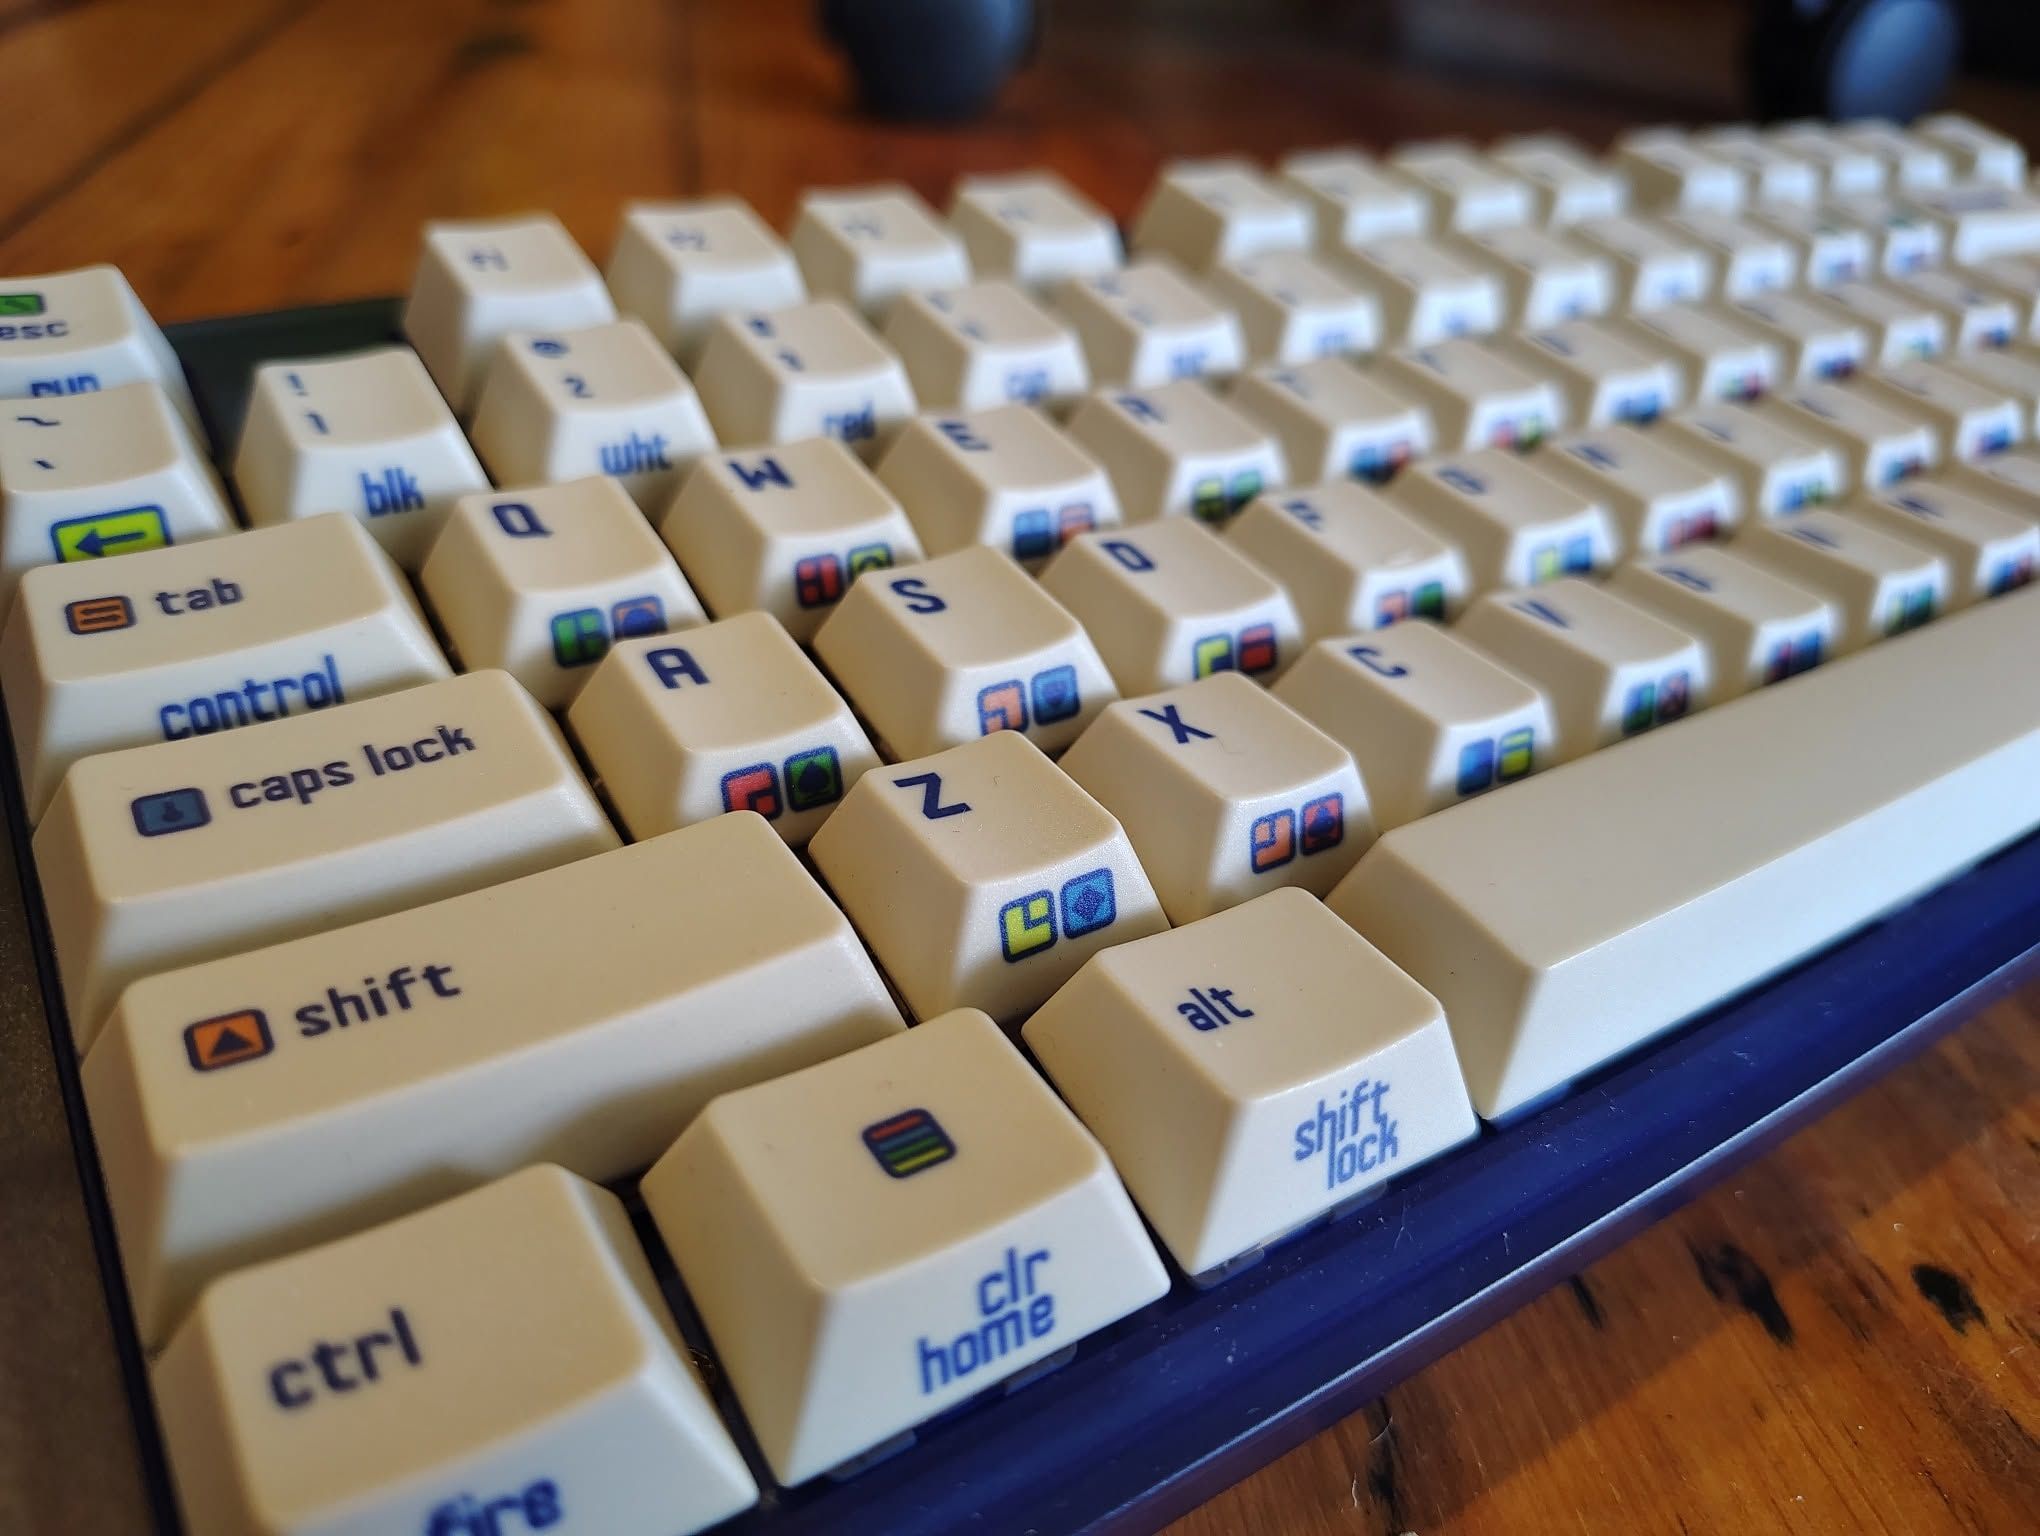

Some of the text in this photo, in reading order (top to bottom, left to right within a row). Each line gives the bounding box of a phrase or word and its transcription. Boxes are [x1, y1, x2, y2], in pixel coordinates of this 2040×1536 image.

[0, 320, 68, 341] esc
[599, 432, 672, 477] wht
[937, 420, 991, 452] E
[359, 466, 424, 517] blk
[728, 455, 795, 492] W
[491, 502, 553, 538] Q
[1100, 540, 1156, 573] D
[154, 578, 244, 616] tab
[890, 578, 947, 615] S
[645, 647, 711, 690] A
[1347, 646, 1408, 677] C
[159, 654, 346, 742] control
[1137, 704, 1216, 744] X
[229, 724, 476, 805] caps lock
[892, 771, 972, 820] Z
[295, 962, 462, 1038] shift
[1177, 985, 1255, 1032] alt
[1294, 1079, 1392, 1162] shift
[1327, 1117, 1399, 1190] lock
[977, 1246, 1052, 1317] clr
[266, 1306, 423, 1411] ctrl
[916, 1294, 1055, 1395] home
